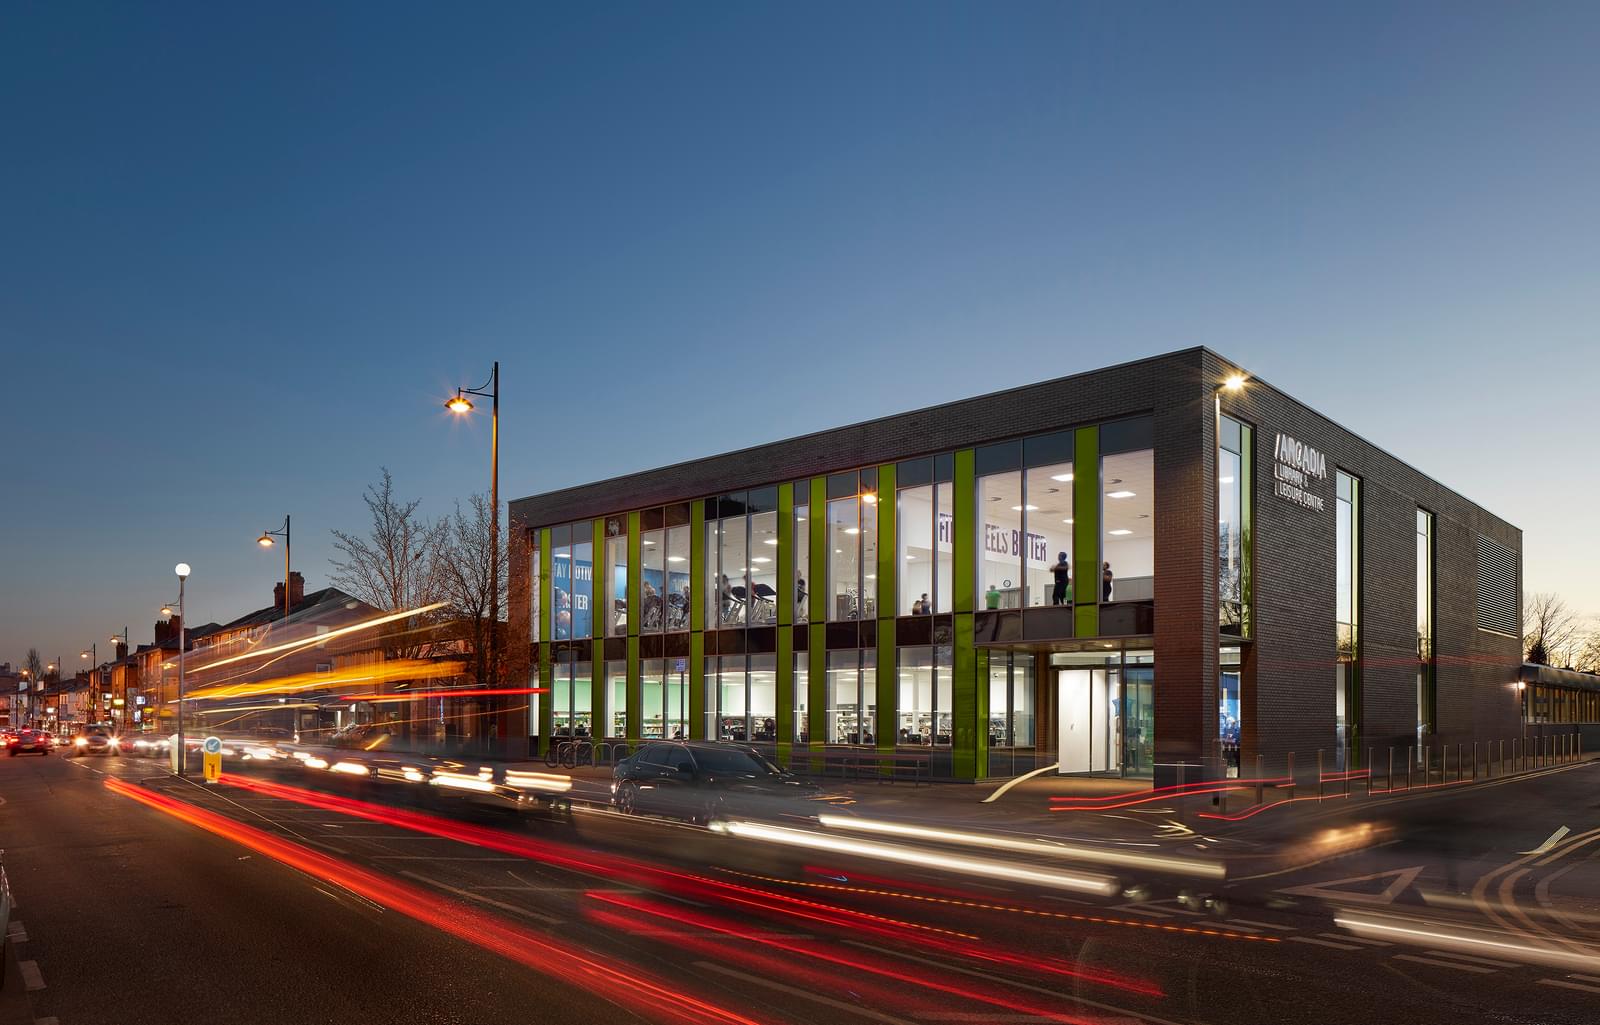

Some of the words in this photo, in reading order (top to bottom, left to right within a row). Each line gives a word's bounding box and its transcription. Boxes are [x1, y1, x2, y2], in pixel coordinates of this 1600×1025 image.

[1280, 434, 1327, 479] ARCADIA
[1280, 481, 1302, 503] LEISURE
[1303, 491, 1324, 512] CENTRE
[985, 523, 1008, 554] EELS
